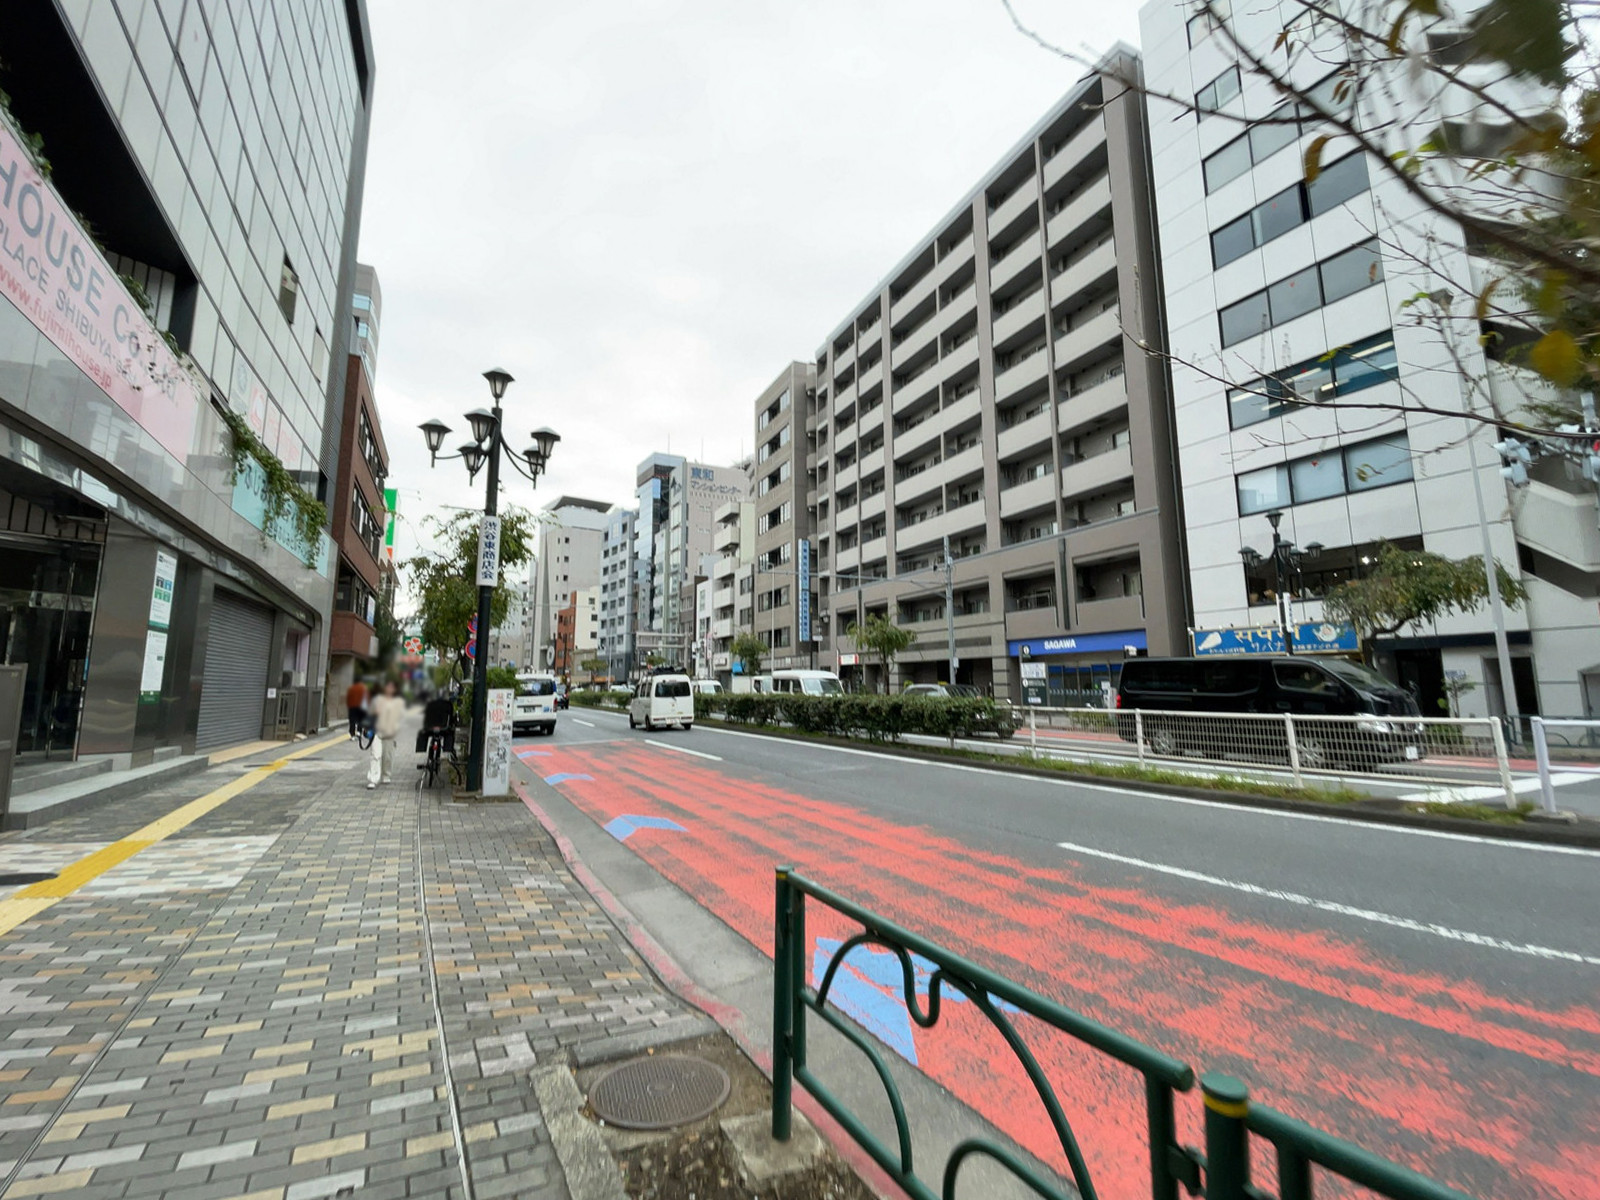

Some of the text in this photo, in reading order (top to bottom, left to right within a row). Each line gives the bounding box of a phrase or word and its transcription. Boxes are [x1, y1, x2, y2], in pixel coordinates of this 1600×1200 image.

[0, 160, 105, 317] HOUSE
[482, 521, 497, 579] 渋谷東商店会
[1044, 638, 1077, 650] SAGAWA
